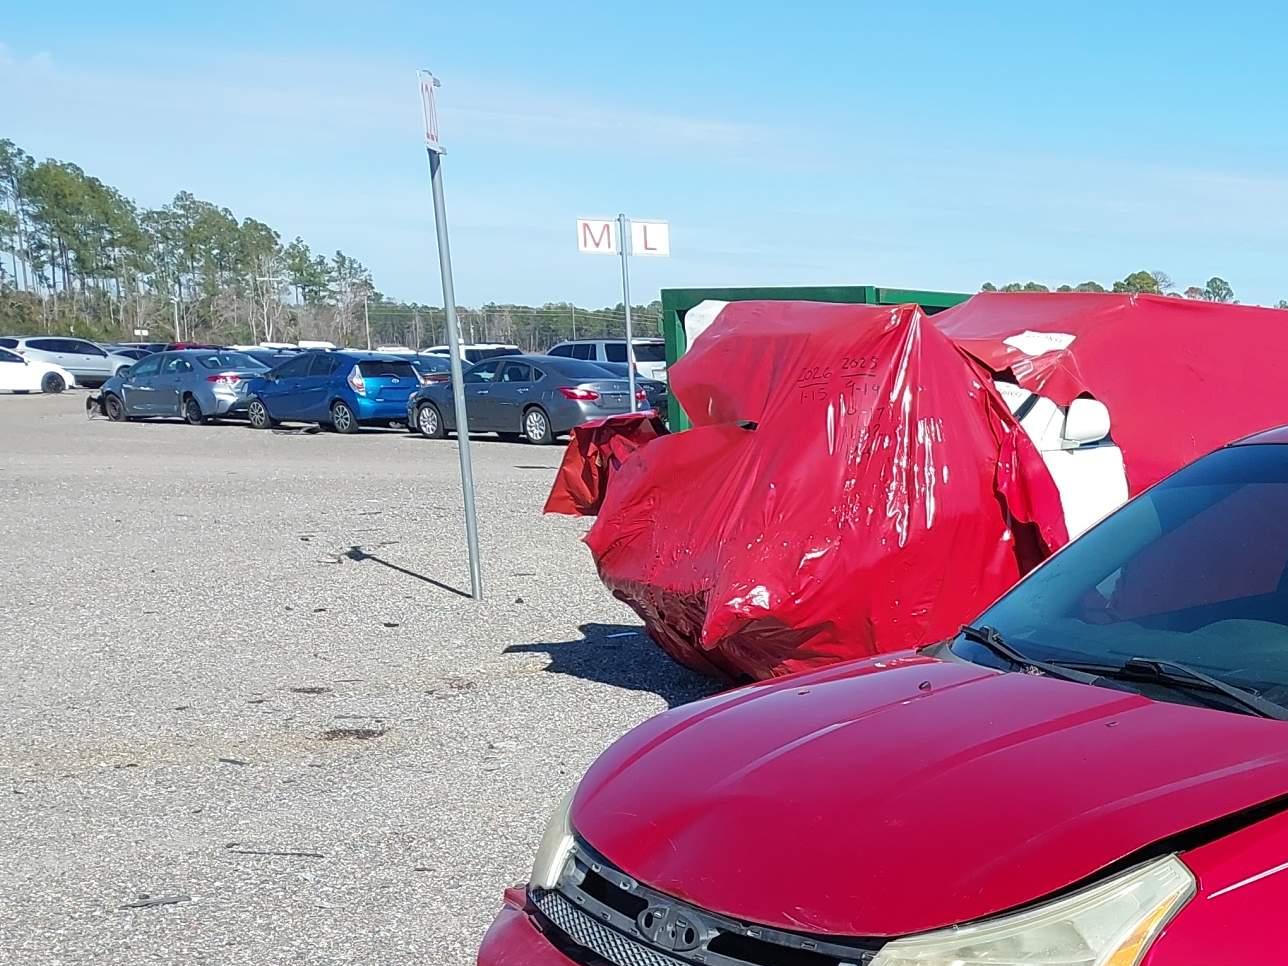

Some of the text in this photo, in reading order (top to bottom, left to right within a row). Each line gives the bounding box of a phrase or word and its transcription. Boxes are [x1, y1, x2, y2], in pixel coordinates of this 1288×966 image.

[582, 222, 611, 249] M
[642, 224, 658, 251] L
[841, 356, 879, 370] 2025
